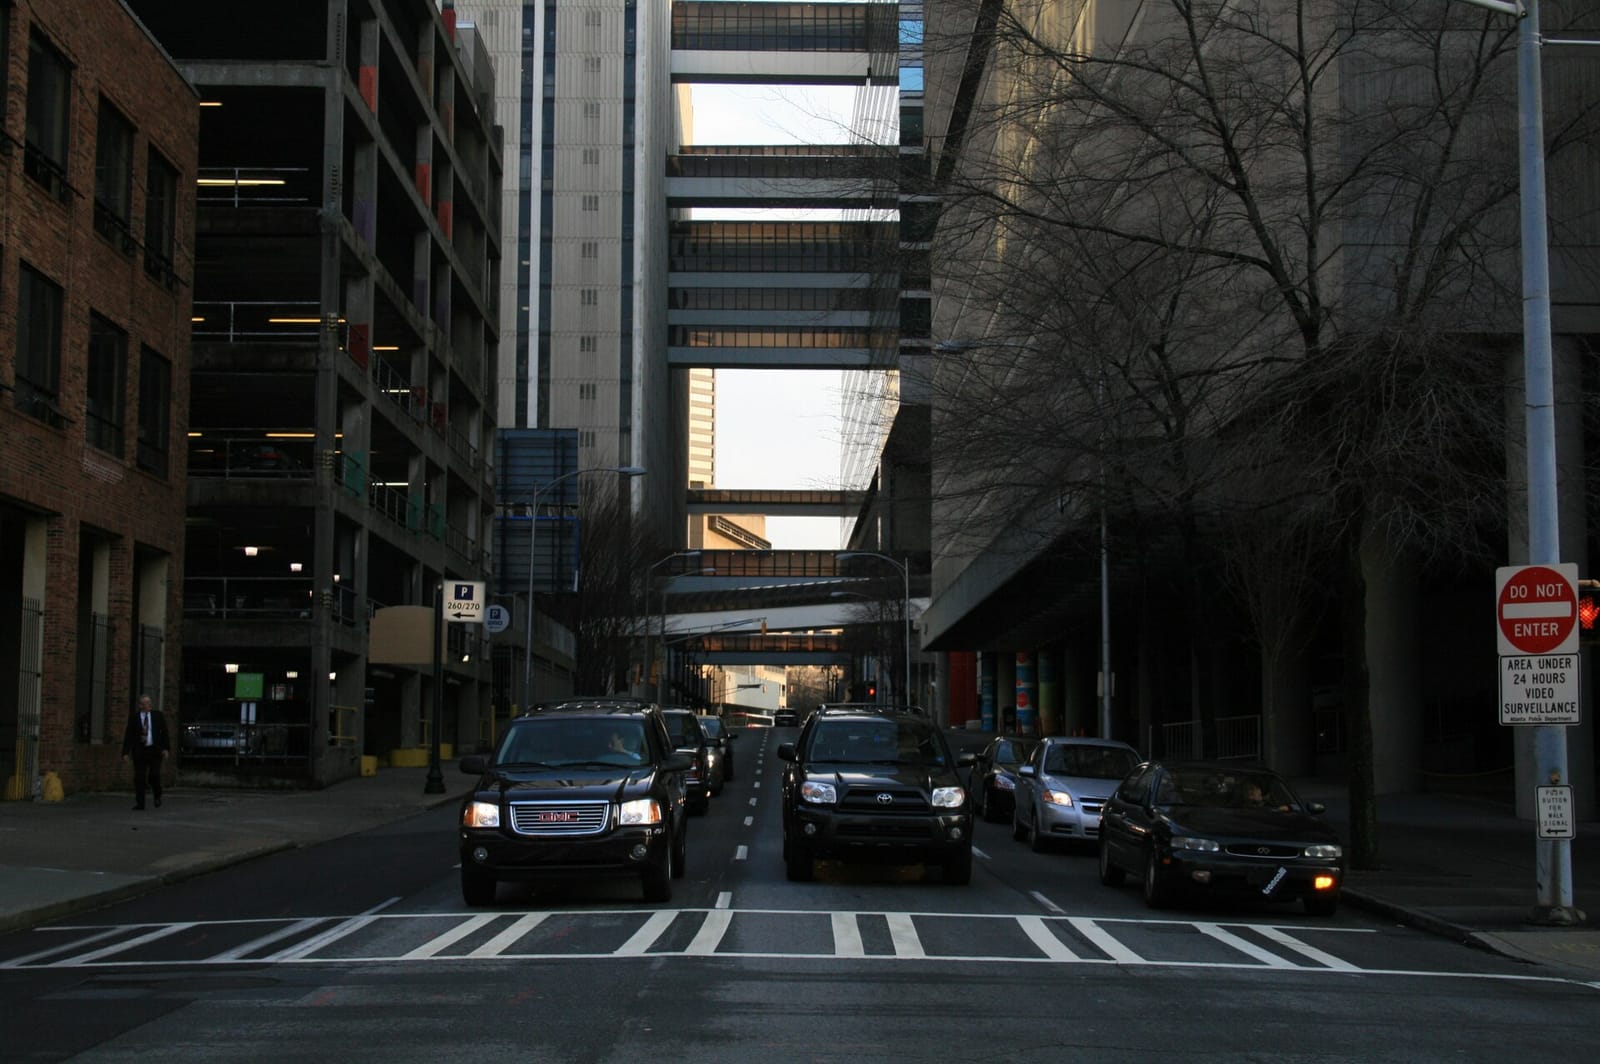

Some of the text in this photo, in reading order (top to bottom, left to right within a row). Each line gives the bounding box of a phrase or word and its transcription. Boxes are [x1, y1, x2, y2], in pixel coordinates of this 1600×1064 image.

[461, 587, 468, 597] P
[1510, 583, 1564, 599] DO NOT
[448, 602, 480, 610] 260/270
[1514, 622, 1559, 637] ENTER
[1507, 657, 1571, 671] AREA UNDER
[1513, 673, 1566, 685] 24 HOURS
[1525, 687, 1554, 699] VIDEO
[1504, 702, 1576, 714] SURVEILLANCE
[539, 812, 576, 822] GMC
